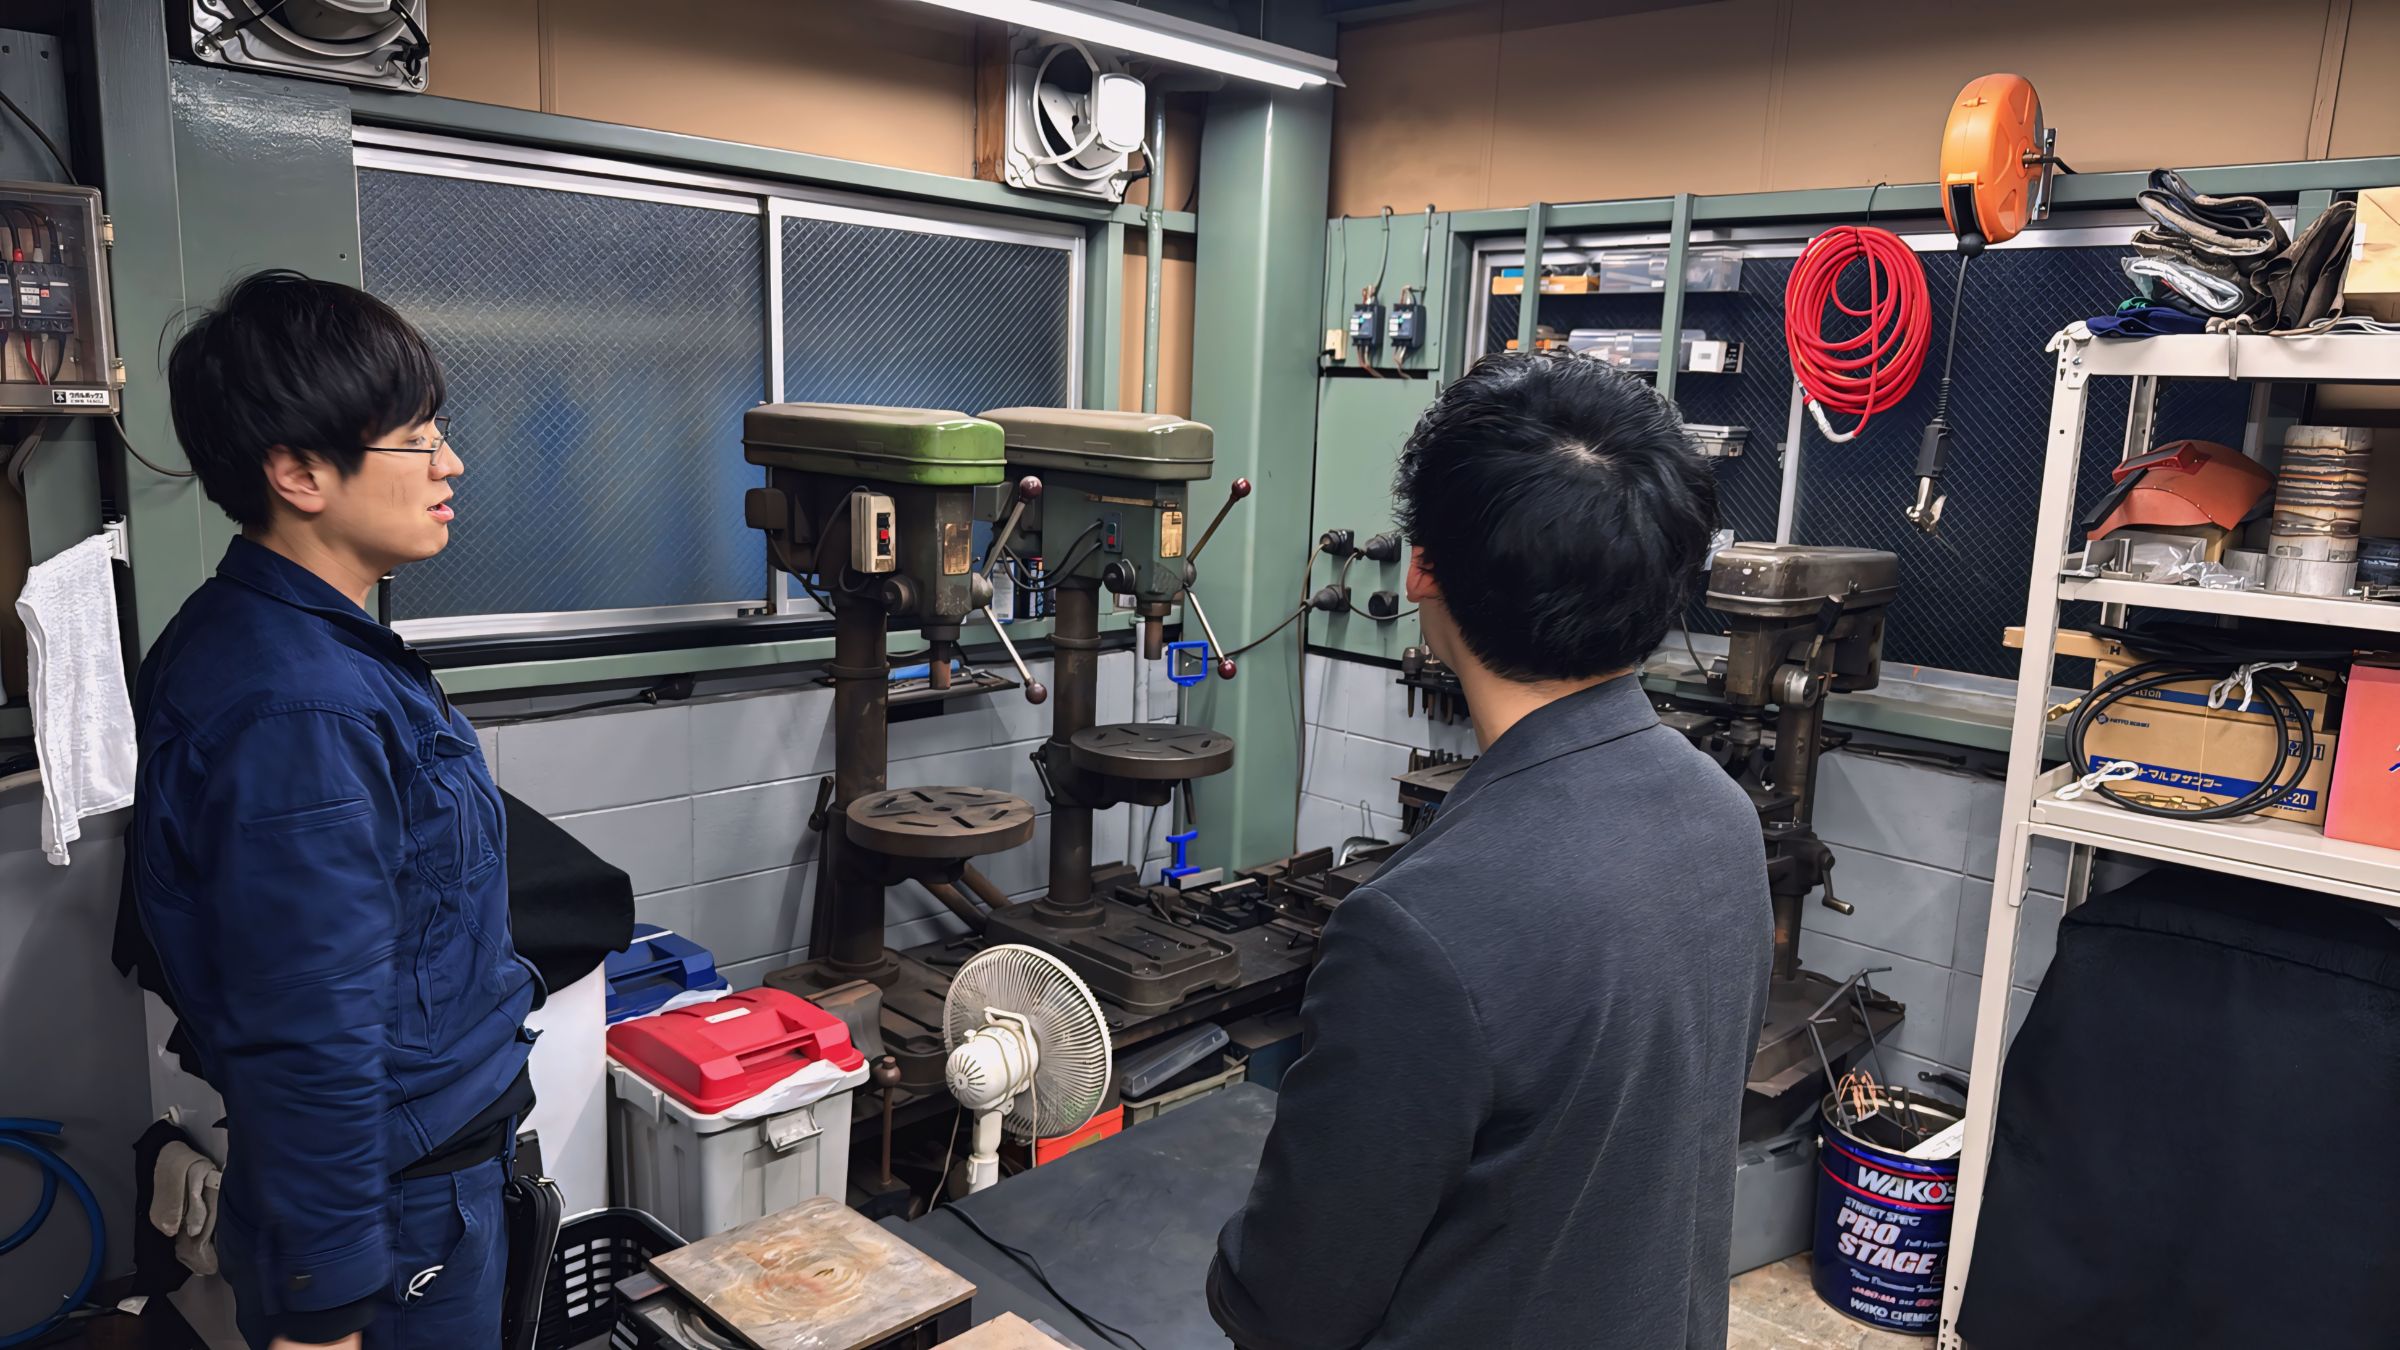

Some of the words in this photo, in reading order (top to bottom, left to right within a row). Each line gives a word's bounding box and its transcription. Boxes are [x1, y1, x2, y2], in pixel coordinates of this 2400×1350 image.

[1836, 1206, 1901, 1245] PRO
[1837, 1232, 1938, 1275] STAGE
[1850, 1297, 1889, 1319] WAKO
